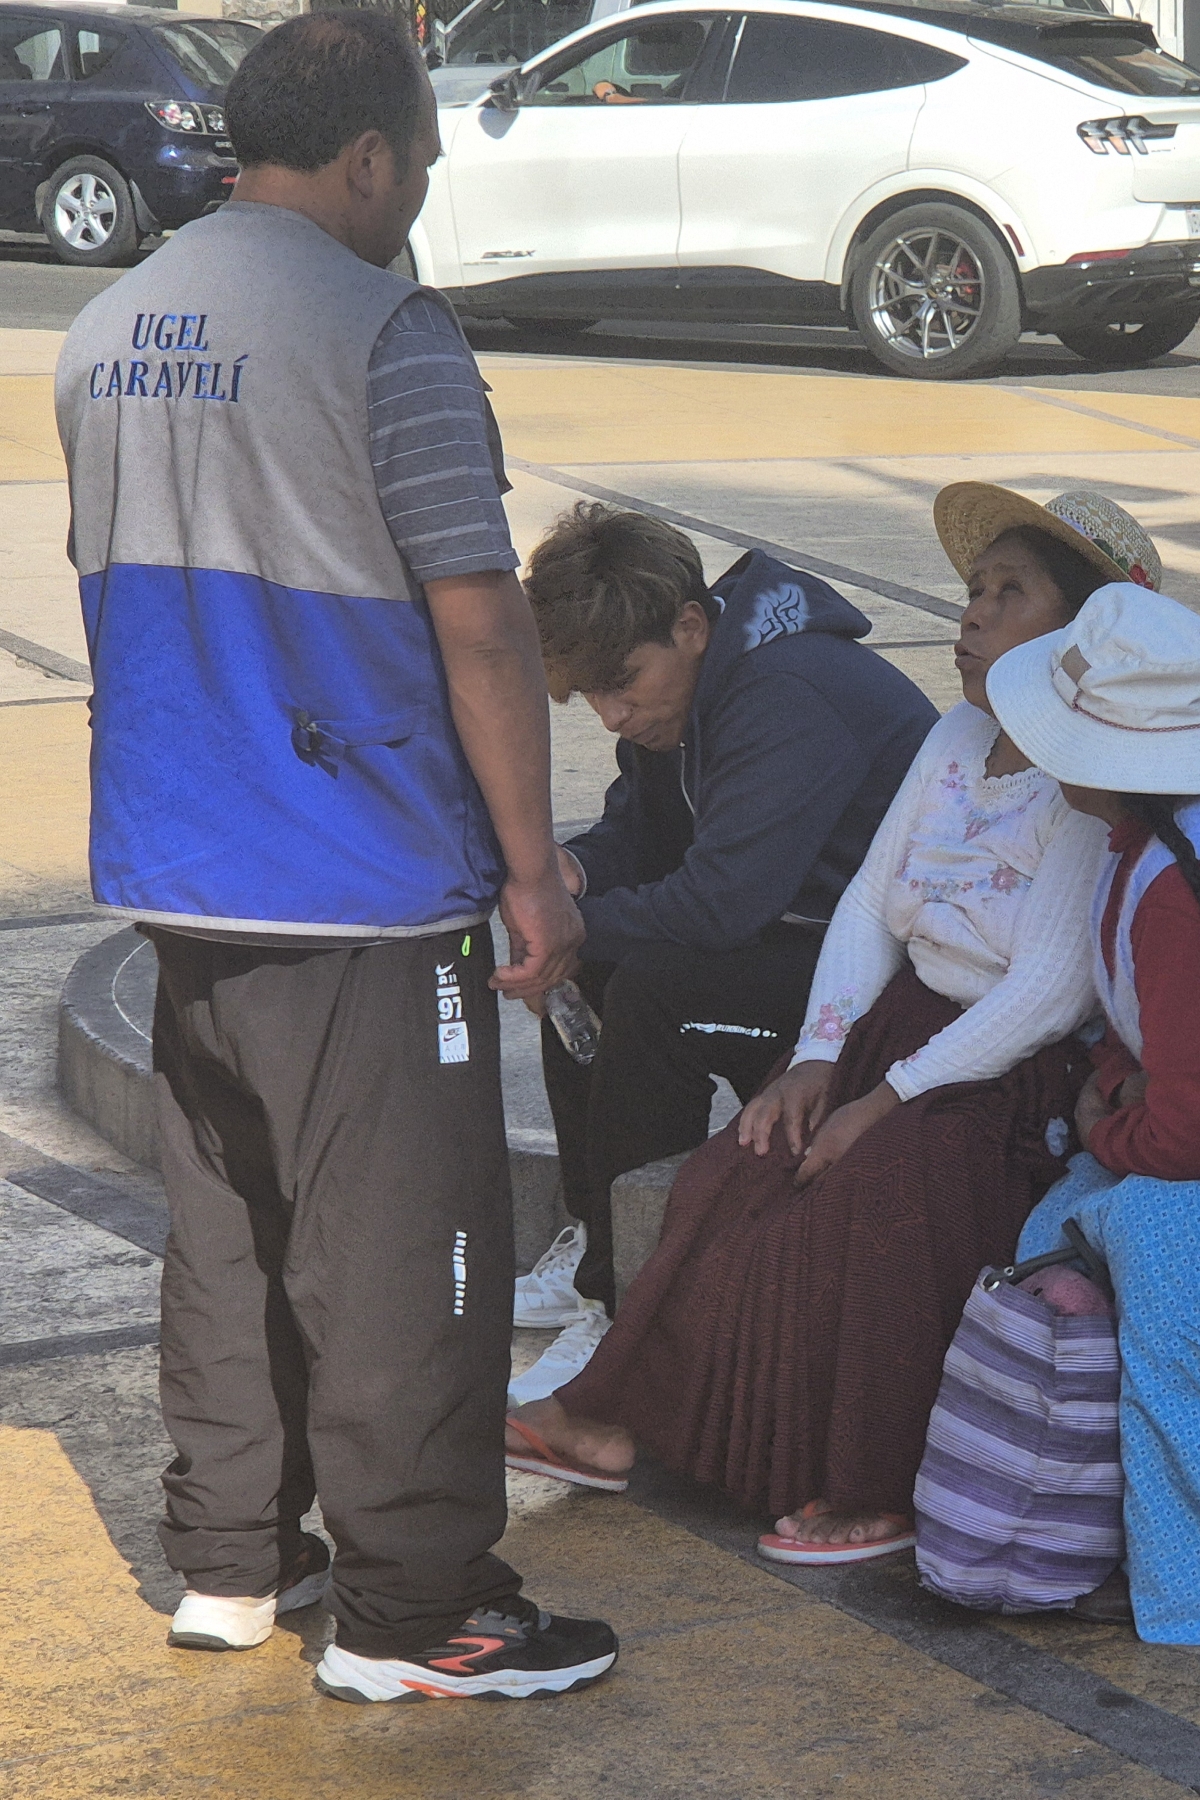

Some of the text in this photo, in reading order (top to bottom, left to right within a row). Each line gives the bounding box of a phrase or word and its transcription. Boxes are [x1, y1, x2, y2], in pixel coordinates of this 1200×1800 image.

[132, 313, 209, 351] UGEL
[89, 354, 249, 403] CARAVELÍ
[438, 996, 462, 1020] 97
